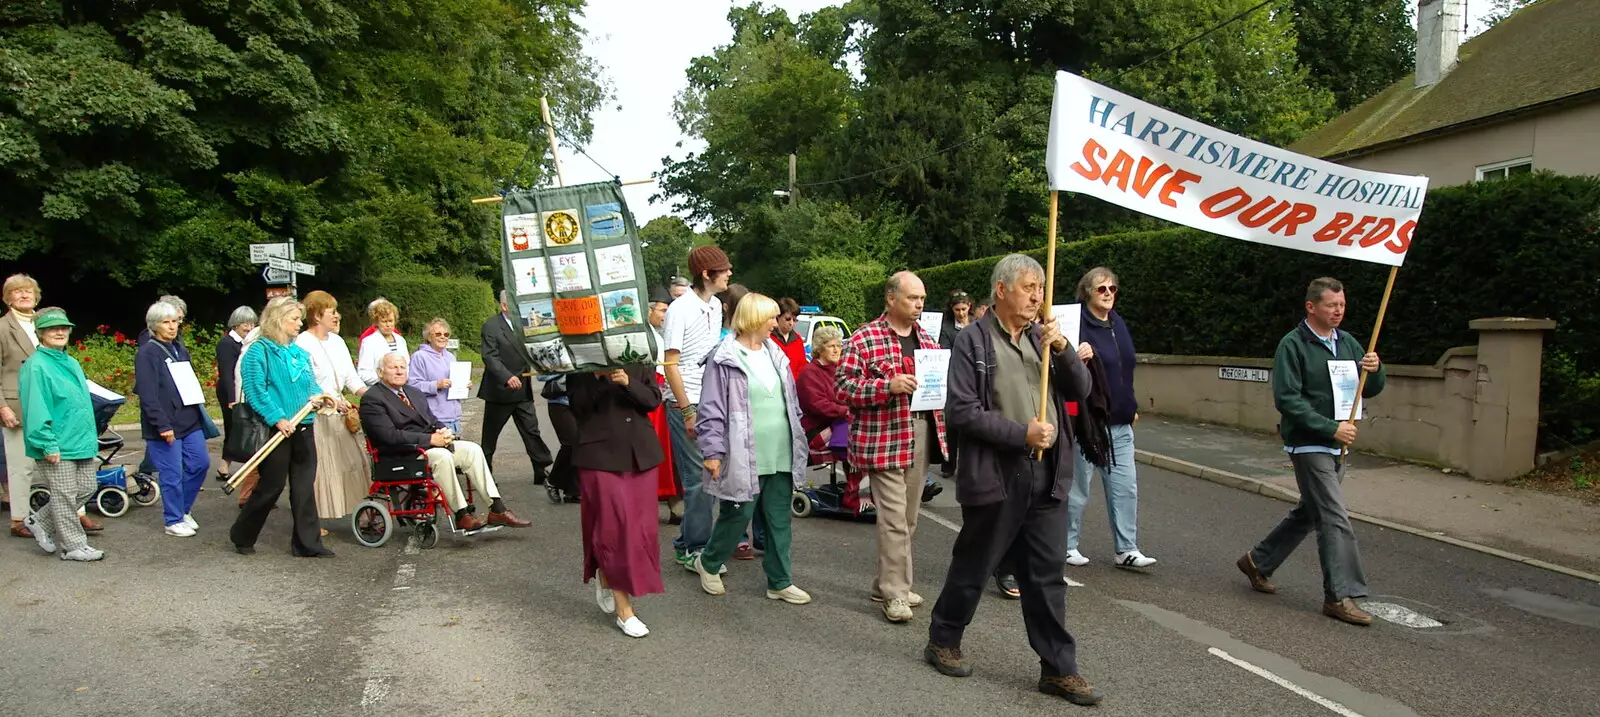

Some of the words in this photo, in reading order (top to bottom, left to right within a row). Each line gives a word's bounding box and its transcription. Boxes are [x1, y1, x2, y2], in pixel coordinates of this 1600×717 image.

[1089, 95, 1317, 190] HARTISMERE
[1314, 173, 1421, 210] HOSPITAL
[1069, 138, 1202, 208] SAVE
[1199, 186, 1317, 236] OUR
[1312, 212, 1417, 254] BEDS
[559, 256, 576, 265] EYE
[556, 299, 579, 312] SAVE
[581, 298, 598, 310] OUR
[559, 313, 600, 326] SERVICES
[1251, 370, 1266, 381] HILL
